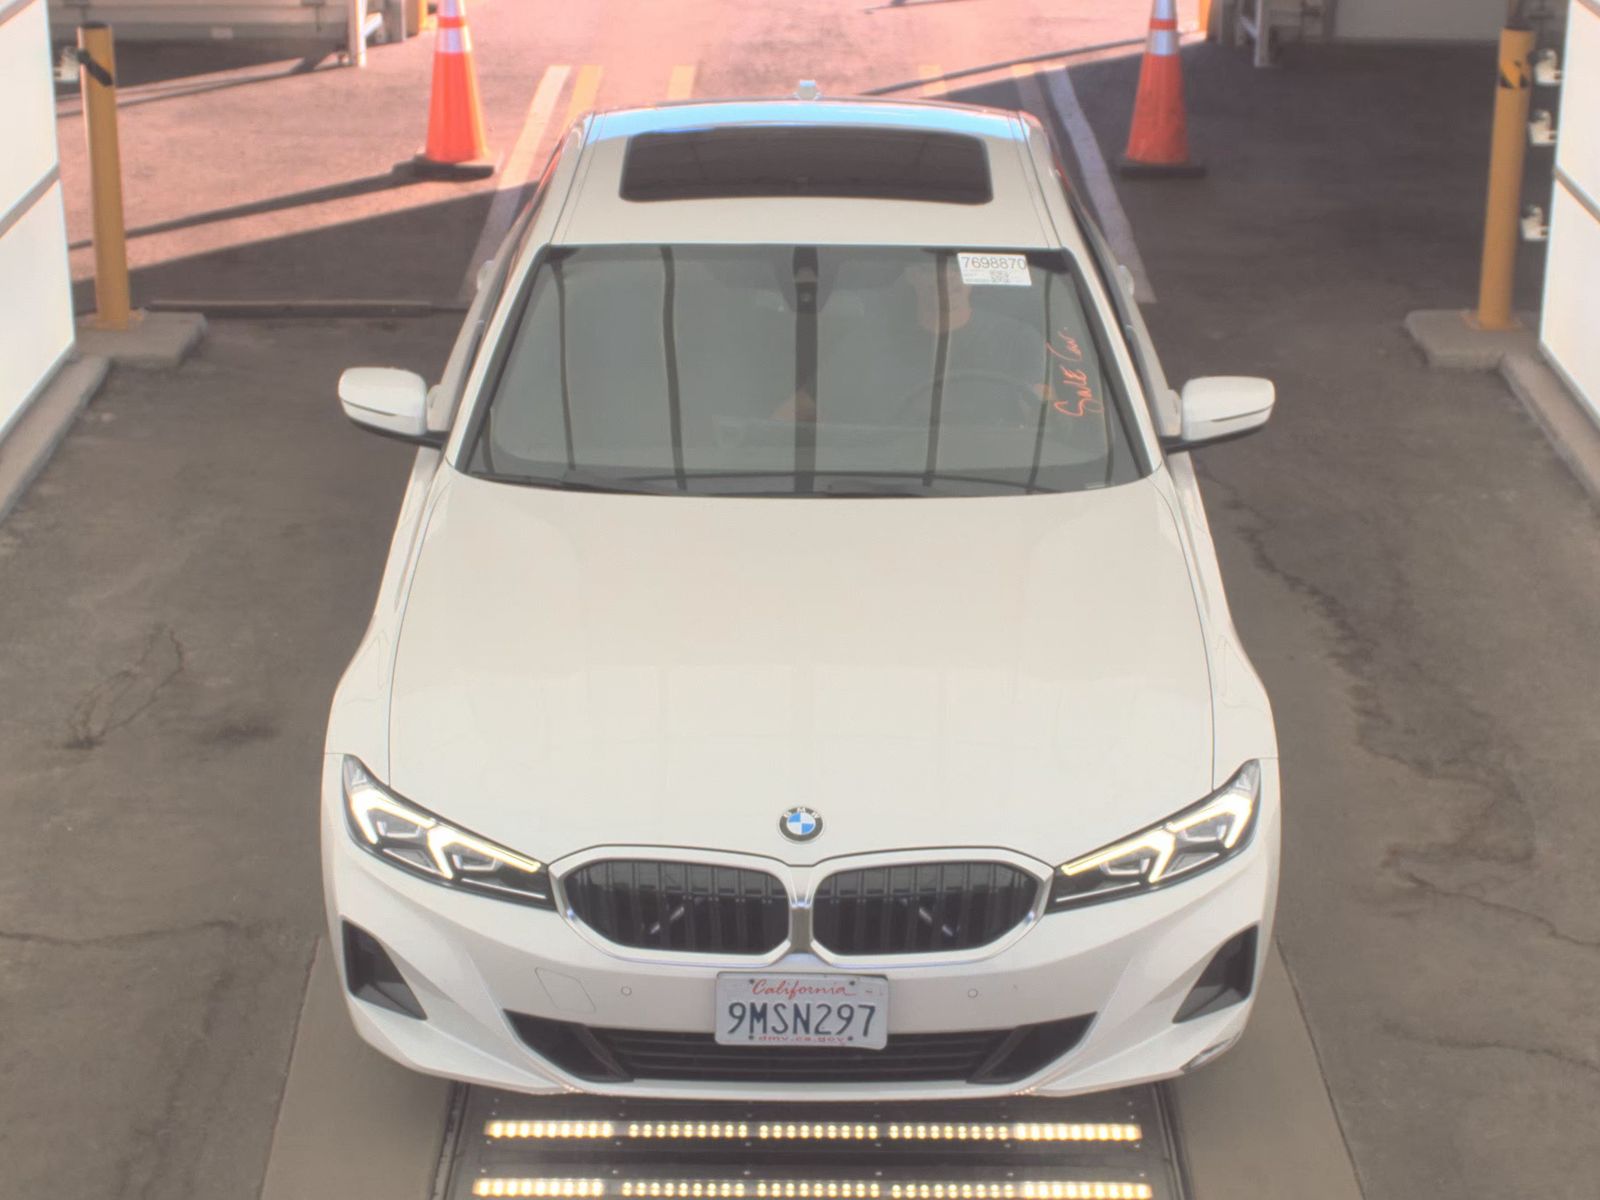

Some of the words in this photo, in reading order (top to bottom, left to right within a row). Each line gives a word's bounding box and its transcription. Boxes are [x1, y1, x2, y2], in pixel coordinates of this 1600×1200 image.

[960, 256, 1027, 270] 7698870
[751, 978, 856, 1000] California
[727, 1001, 876, 1037] 9MSN297
